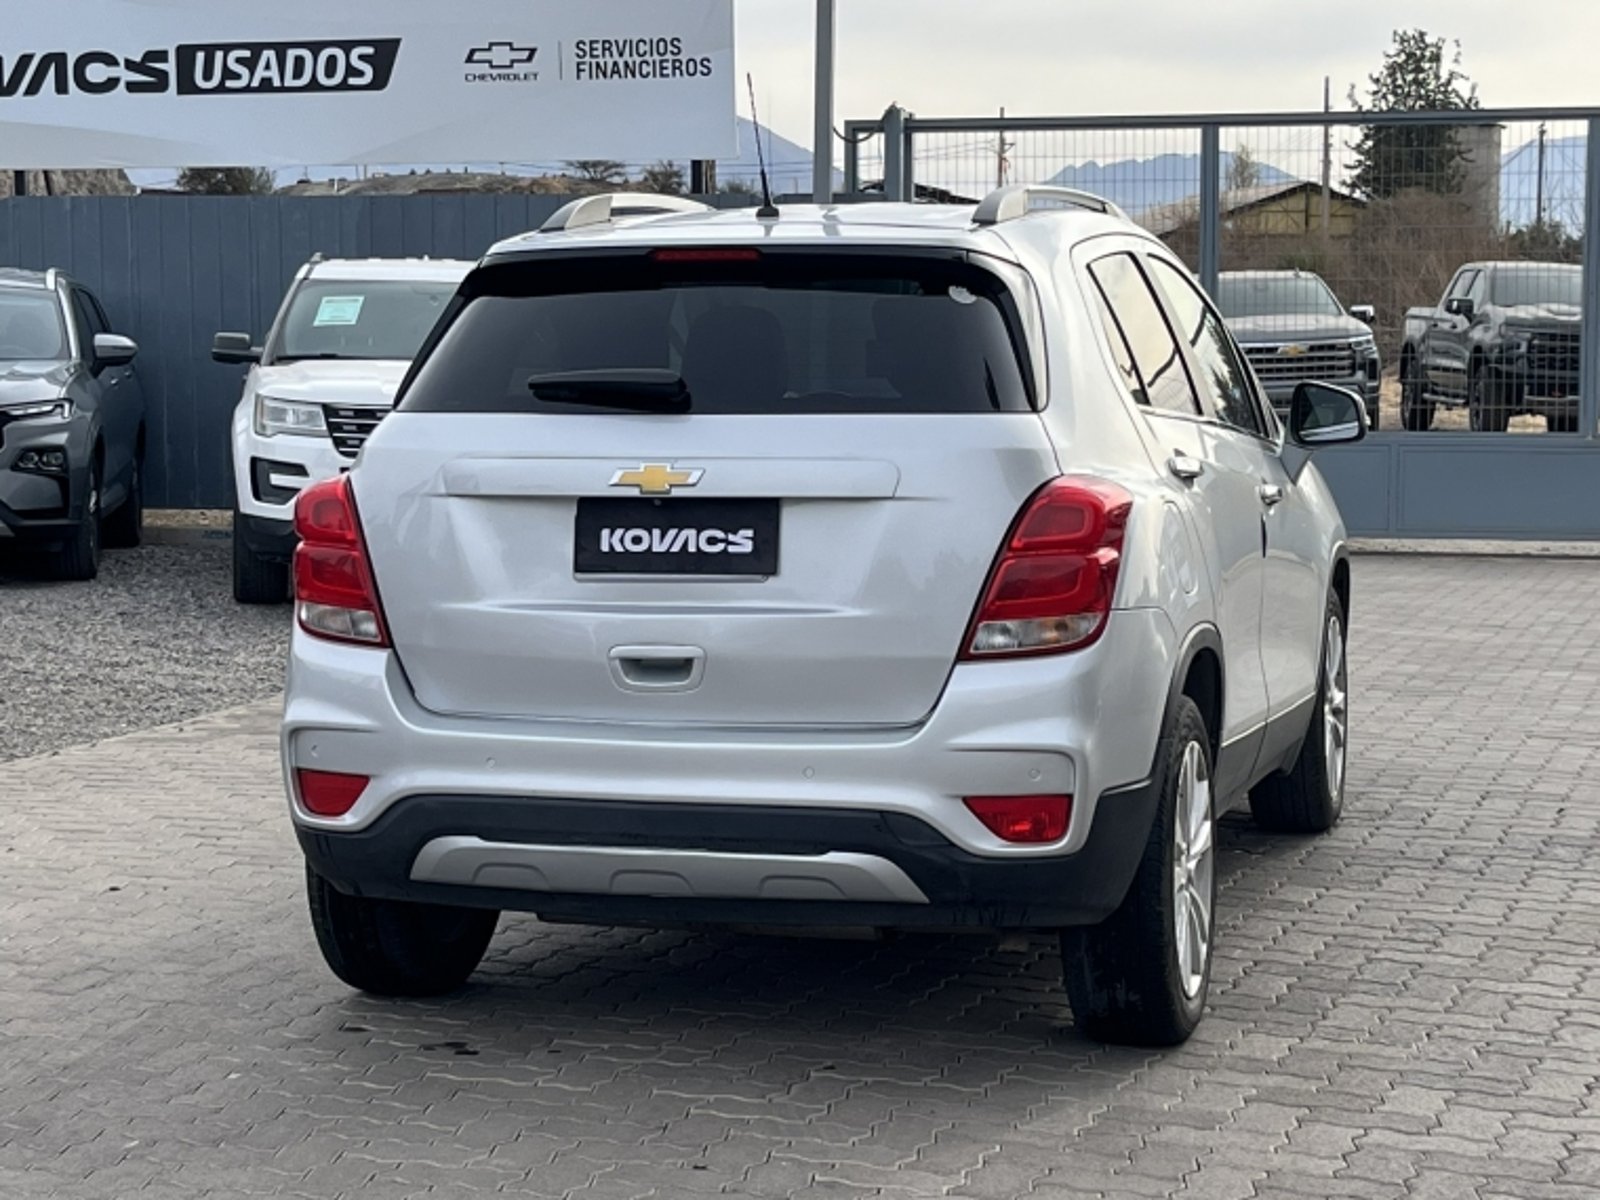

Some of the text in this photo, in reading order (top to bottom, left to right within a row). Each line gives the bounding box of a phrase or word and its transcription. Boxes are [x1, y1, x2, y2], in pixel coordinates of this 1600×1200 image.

[575, 37, 682, 59] SERVICIOS
[194, 46, 375, 89] USADOS
[464, 71, 539, 82] CHEVROLET
[575, 57, 713, 80] FINANCIEROS
[600, 528, 754, 553] KOVACS
